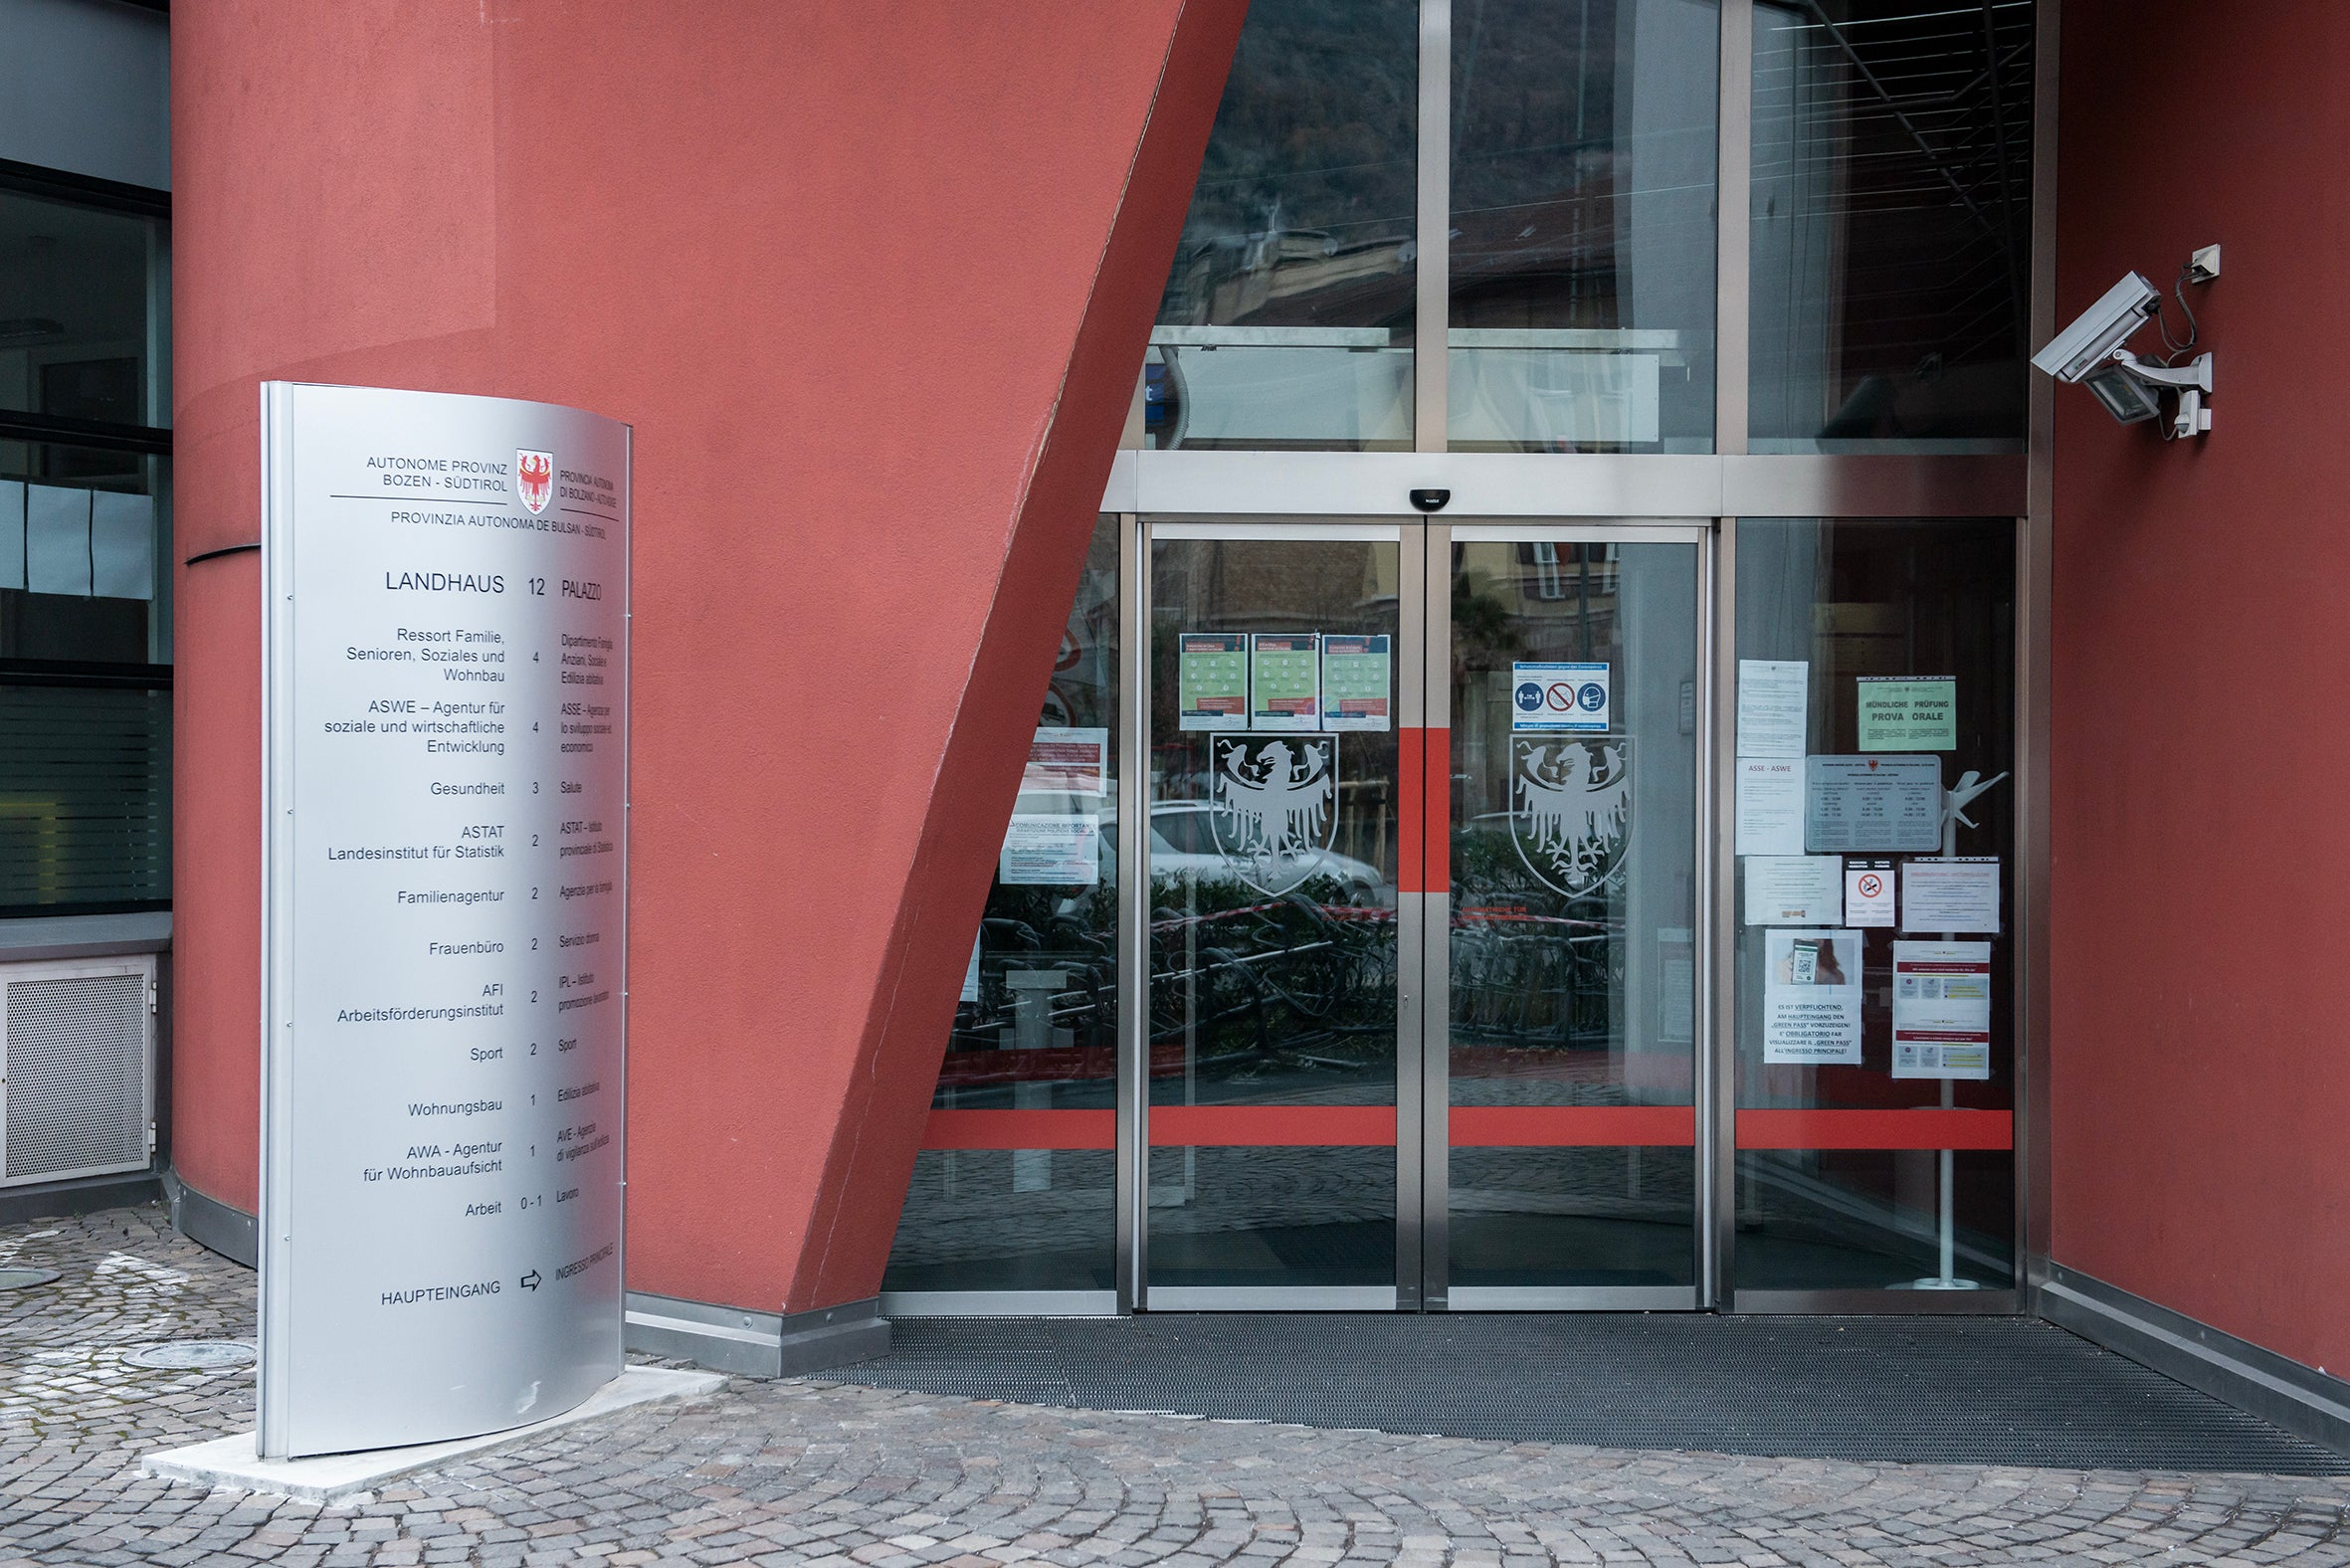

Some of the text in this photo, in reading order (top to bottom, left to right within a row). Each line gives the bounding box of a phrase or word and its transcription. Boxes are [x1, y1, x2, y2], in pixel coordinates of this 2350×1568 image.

[366, 456, 508, 476] AUTONOME PROVINZ
[383, 474, 432, 488] BOZEN
[444, 476, 508, 492] SÜDTIROL
[559, 486, 568, 497] DI
[391, 510, 466, 526] PROVINZIA
[468, 514, 535, 531] AUTONOMA
[536, 518, 550, 532] DE
[551, 520, 581, 535] BULSAN
[385, 571, 505, 595] LANDHAUS
[527, 577, 546, 597] 12
[561, 579, 603, 602] PALAZZO
[397, 628, 505, 645] Ressort Familie,
[347, 647, 505, 664] Senioren, Soziales und
[532, 651, 539, 664] 4
[443, 668, 505, 683] Wohnbau
[368, 699, 417, 714] ASWE
[433, 700, 487, 717] Agentur
[489, 700, 505, 715] für
[560, 702, 582, 715] ASSE
[1865, 699, 1949, 708] MÜNDLICHE PRÜFUNG
[1871, 712, 1943, 721] PROVA ORALE
[324, 719, 505, 734] soziale und wirtschaftliche
[532, 721, 539, 733] 4
[427, 739, 505, 756] Entwicklung
[430, 782, 505, 796] Gesundheit
[532, 782, 539, 795] 3
[560, 781, 582, 795] Salute
[462, 825, 505, 839] ASTAT
[560, 821, 584, 835] ASTAT
[532, 835, 539, 847] 2
[328, 845, 505, 861] Landesinstitut für Statistik
[397, 889, 504, 905] Familienagentur
[531, 887, 538, 900] 2
[559, 884, 585, 900] Agenzia
[429, 940, 504, 956] Frauenbüro
[531, 938, 538, 951] 2
[559, 935, 585, 948] Servizio
[483, 983, 504, 997] AFI
[558, 976, 571, 989] IPL
[531, 990, 538, 1003] 2
[337, 1003, 504, 1023] Arbeitsförderungsinstitut
[530, 1043, 537, 1056] 2
[558, 1038, 578, 1053] Sport
[470, 1047, 503, 1064] Sport
[407, 1098, 503, 1117] Wohnungsbau
[530, 1094, 536, 1106] 1
[556, 1126, 573, 1143] AVE
[406, 1145, 442, 1160] AWA
[453, 1141, 503, 1158] Agentur
[530, 1144, 536, 1157] 1
[363, 1159, 503, 1182] für Wohnbauaufsicht
[520, 1197, 528, 1210] 0
[537, 1195, 542, 1207] 1
[556, 1187, 579, 1203] Lavoro
[465, 1201, 502, 1217] Arbeit
[555, 1258, 589, 1281] INGRESSO
[381, 1279, 500, 1305] HAUPTEINGANG
